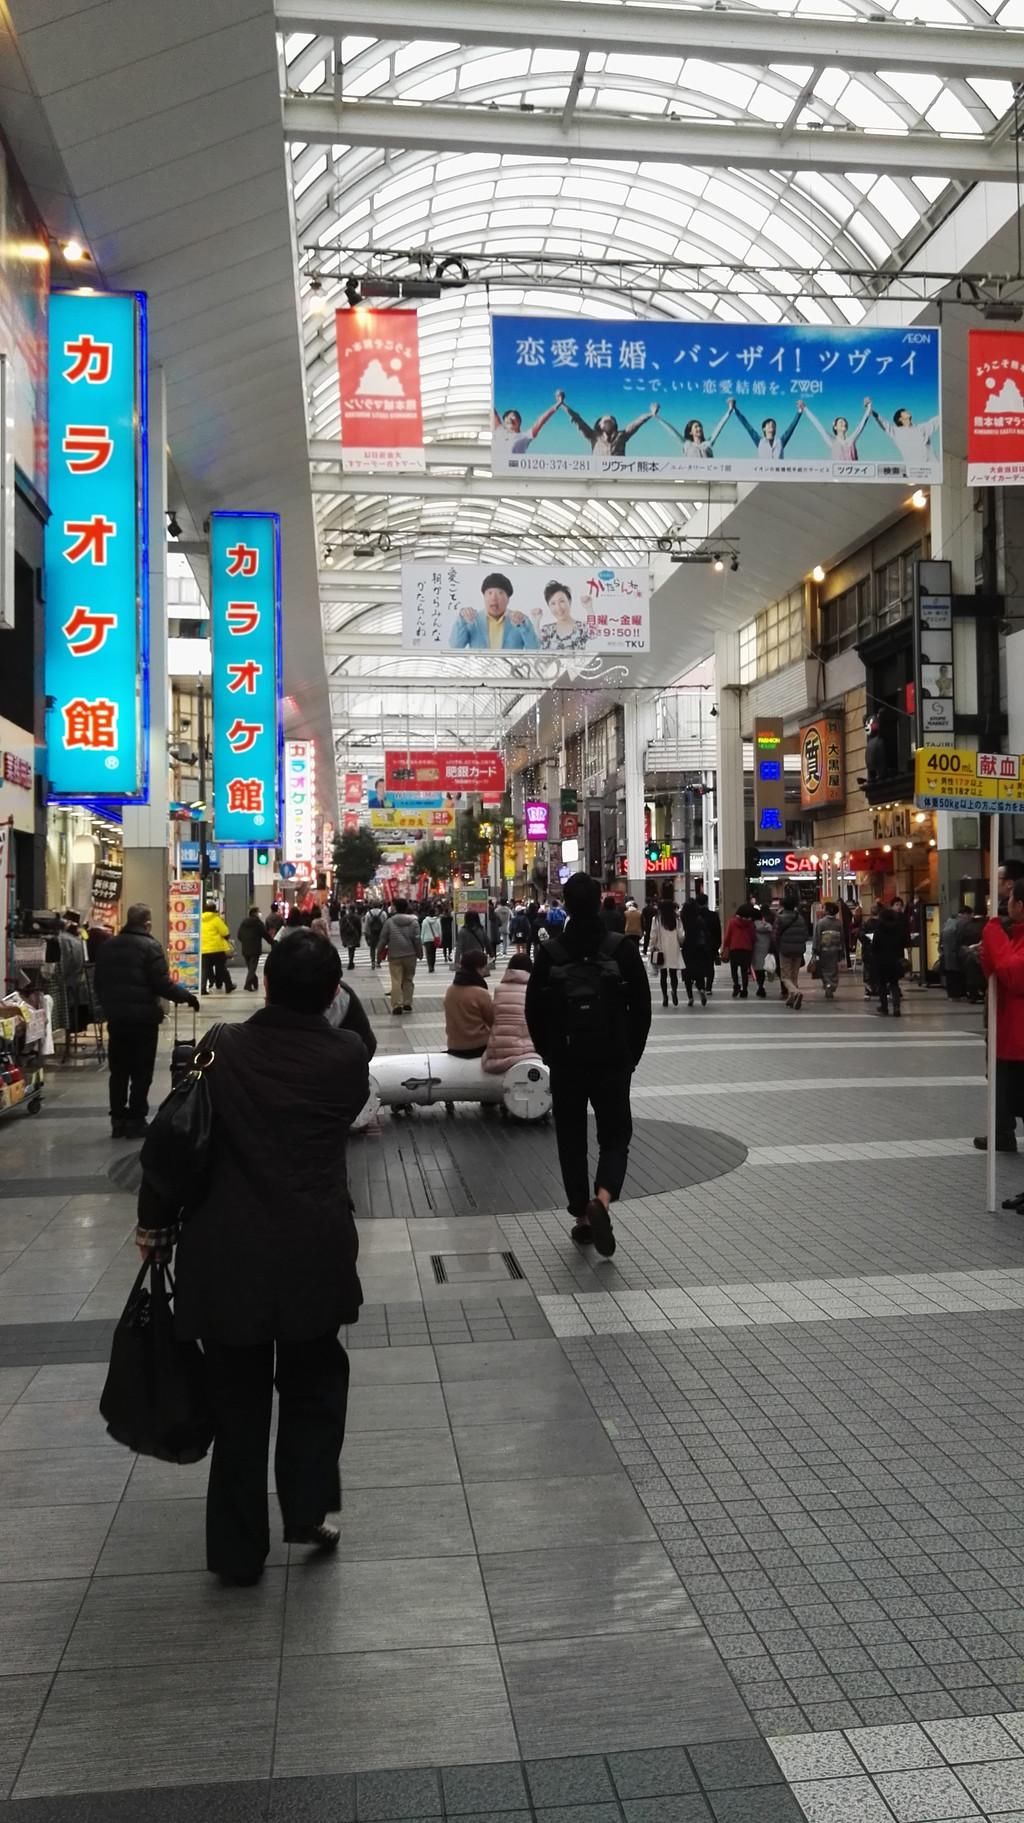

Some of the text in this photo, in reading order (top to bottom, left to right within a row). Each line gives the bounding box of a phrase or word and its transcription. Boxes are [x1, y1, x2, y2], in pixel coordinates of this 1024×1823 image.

[818, 348, 917, 376] ツヴァイ
[622, 378, 785, 396] ここで、いい恋愛結婚を。
[974, 416, 1024, 428] 熊本城マラ
[520, 458, 591, 471] 0120-374-281
[837, 466, 869, 475] ツヴァイ
[62, 336, 118, 750] カラオケ館
[225, 543, 262, 812] カラオケ館
[446, 766, 497, 778] 肥銀カード
[828, 743, 840, 786] 大黒屋
[980, 755, 1016, 777] 献血
